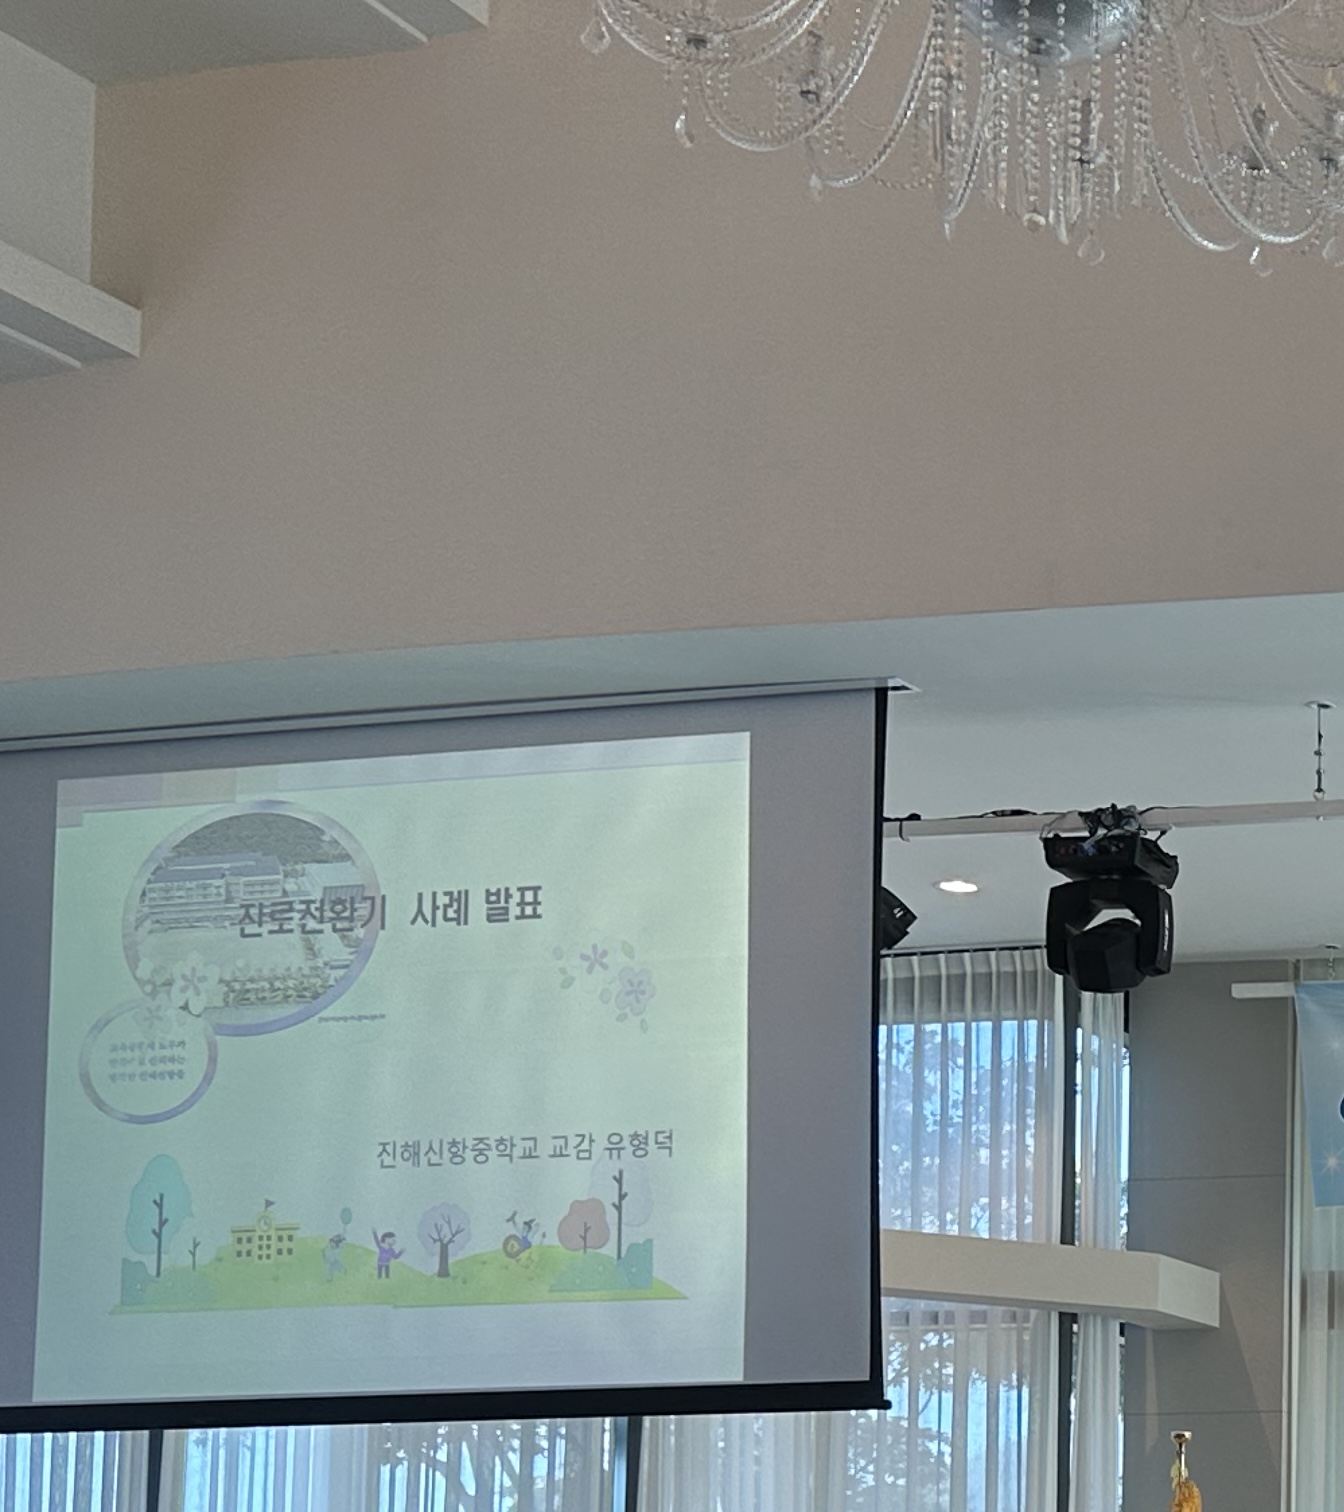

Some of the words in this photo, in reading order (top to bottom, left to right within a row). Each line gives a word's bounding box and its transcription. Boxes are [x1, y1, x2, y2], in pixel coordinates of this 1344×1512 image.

[409, 888, 470, 928] 사례
[484, 885, 543, 924] 발표
[376, 1135, 541, 1170] 진해신항중학교
[548, 1132, 596, 1162] 교감
[603, 1128, 674, 1161] 유형덕
